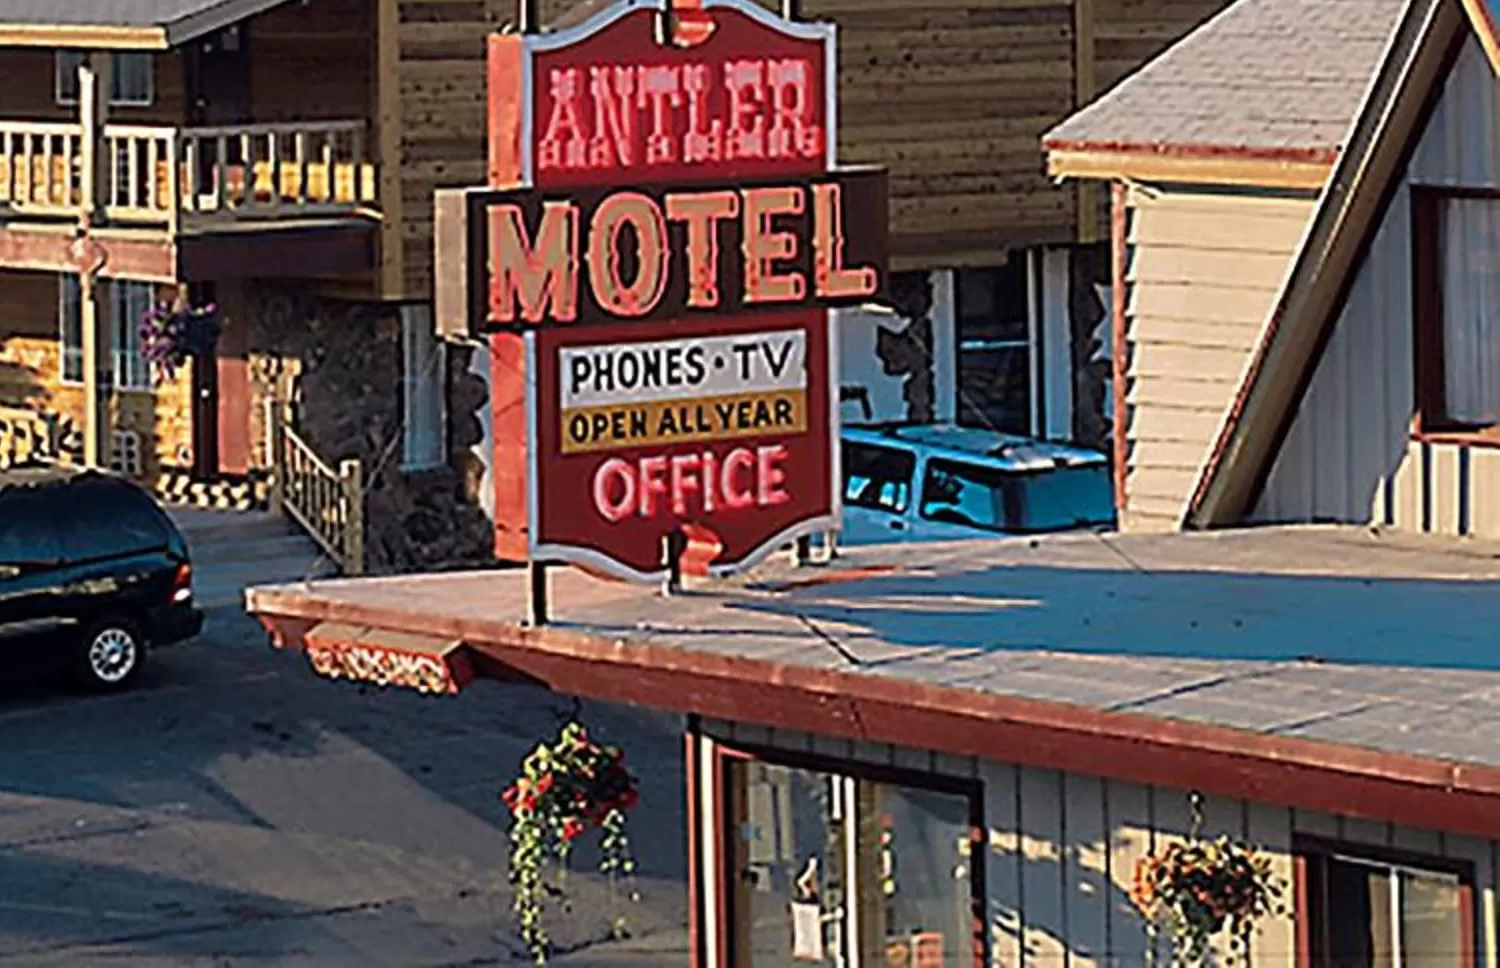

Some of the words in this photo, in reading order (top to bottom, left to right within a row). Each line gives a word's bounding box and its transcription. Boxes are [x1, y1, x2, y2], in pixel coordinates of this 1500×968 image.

[538, 58, 824, 170] ANTLER
[485, 182, 877, 324] MOTEL
[571, 347, 706, 394] PHONES
[733, 340, 793, 381] TV
[568, 411, 648, 444] OPEN
[657, 405, 713, 437] ALL
[715, 398, 794, 431] YEAR
[593, 444, 791, 522] OFFICE
